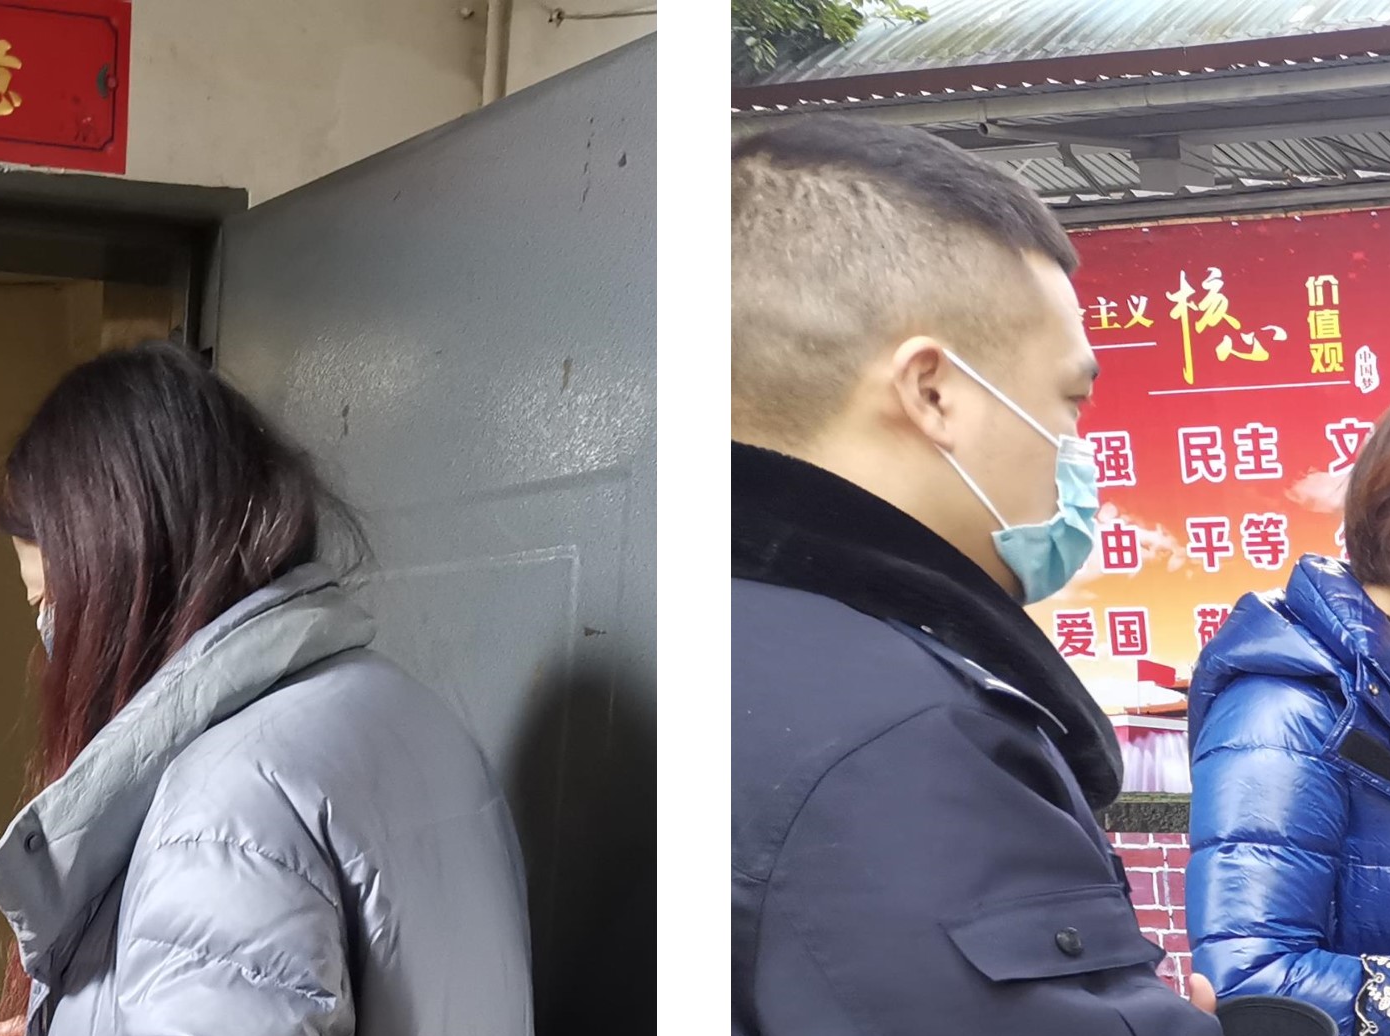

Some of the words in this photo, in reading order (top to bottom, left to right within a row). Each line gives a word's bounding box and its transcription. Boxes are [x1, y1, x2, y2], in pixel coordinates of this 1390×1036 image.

[1076, 294, 1155, 331] 主义
[1165, 266, 1289, 386] 核心
[1305, 274, 1345, 374] 价值观
[1182, 428, 1279, 481] 民主
[1101, 523, 1139, 569] 由
[1188, 517, 1288, 567] 平等
[1057, 610, 1148, 657] 爱国
